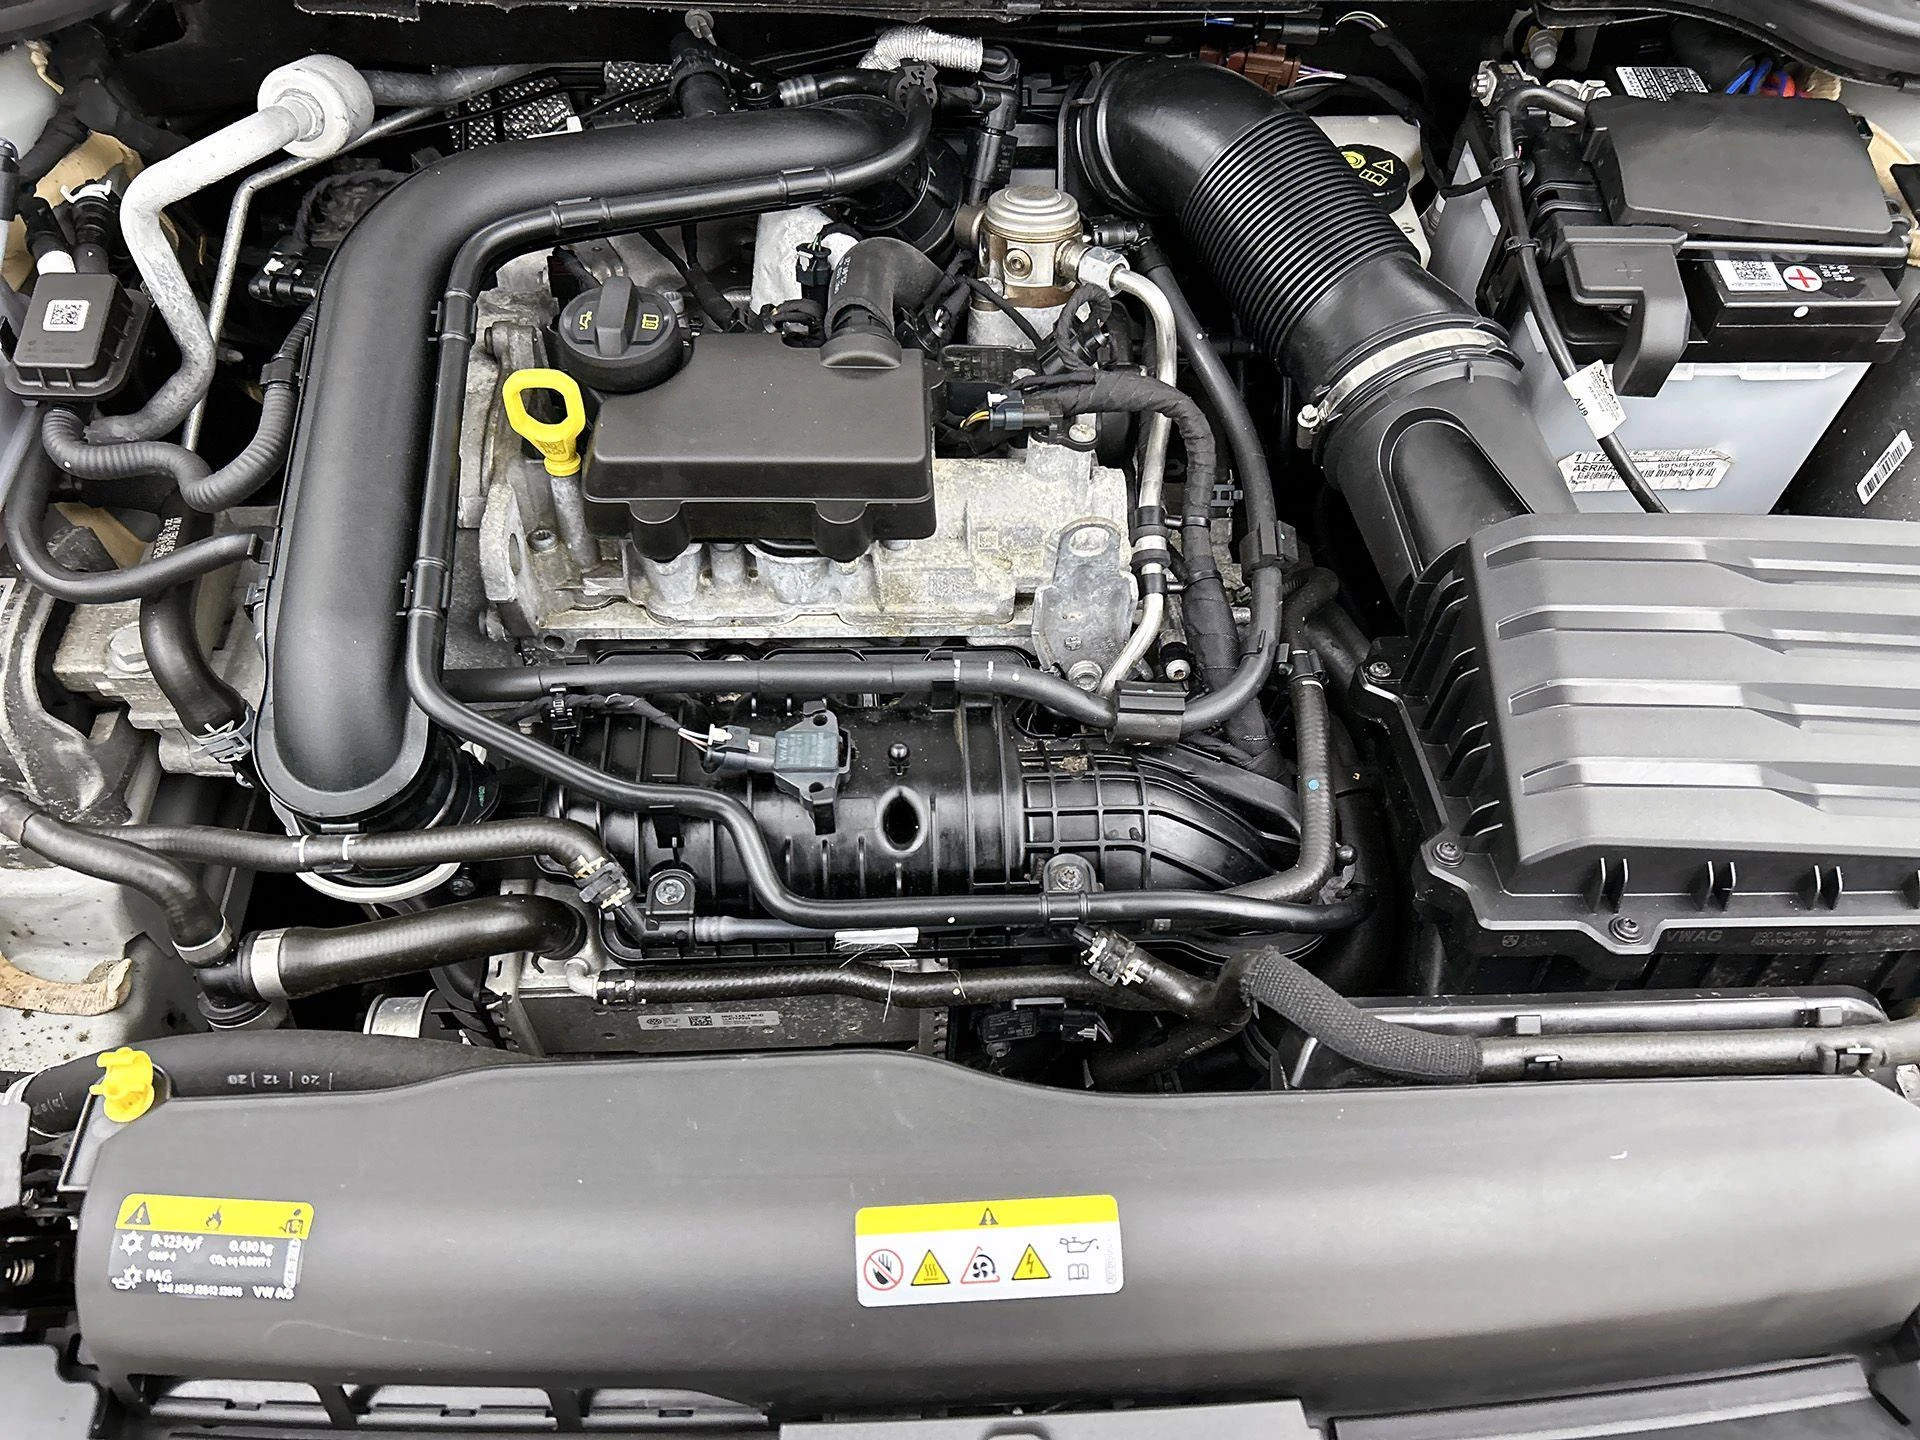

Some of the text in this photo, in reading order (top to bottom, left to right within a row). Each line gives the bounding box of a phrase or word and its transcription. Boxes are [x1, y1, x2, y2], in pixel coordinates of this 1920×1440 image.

[1574, 398, 1588, 416] AU9
[145, 1268, 173, 1283] PAG
[252, 1285, 275, 1299] VW
[274, 1287, 295, 1300] AG
